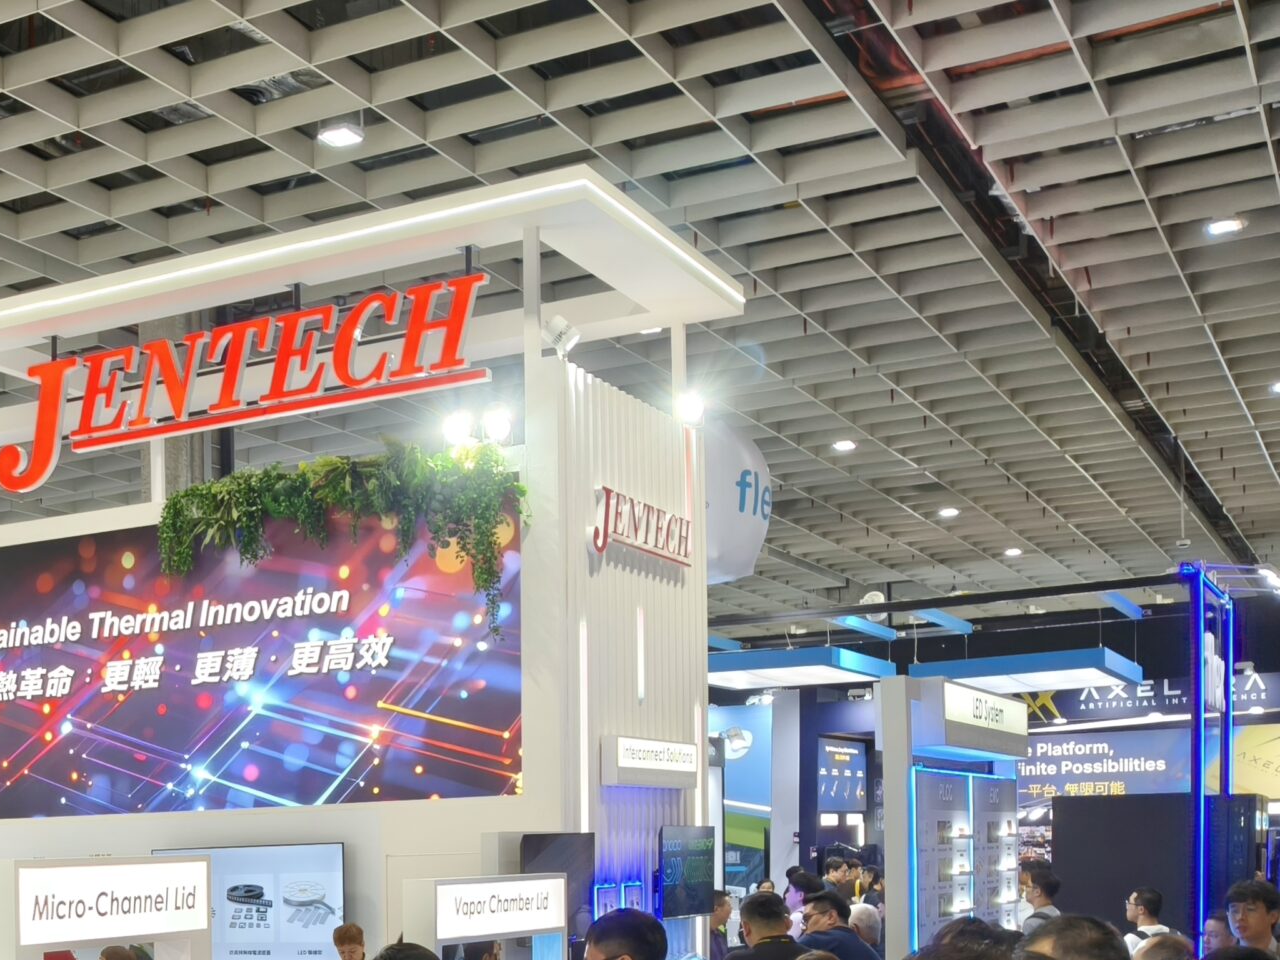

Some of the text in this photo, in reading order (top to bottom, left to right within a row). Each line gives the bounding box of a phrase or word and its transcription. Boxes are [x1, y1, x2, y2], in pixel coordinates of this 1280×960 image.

[593, 486, 691, 558] JENTECH
[88, 602, 192, 639] Thermal
[199, 589, 350, 628] Innovation
[972, 697, 1005, 727] LED System
[1079, 700, 1157, 710] ARTIFICIAL
[622, 744, 693, 764] Interconnect Solutions
[1036, 741, 1114, 757] Platform,
[1061, 757, 1167, 776] Possibilities
[32, 885, 196, 921] Micro-Channel Lid
[454, 890, 549, 919] Vapor Chamber Lid
